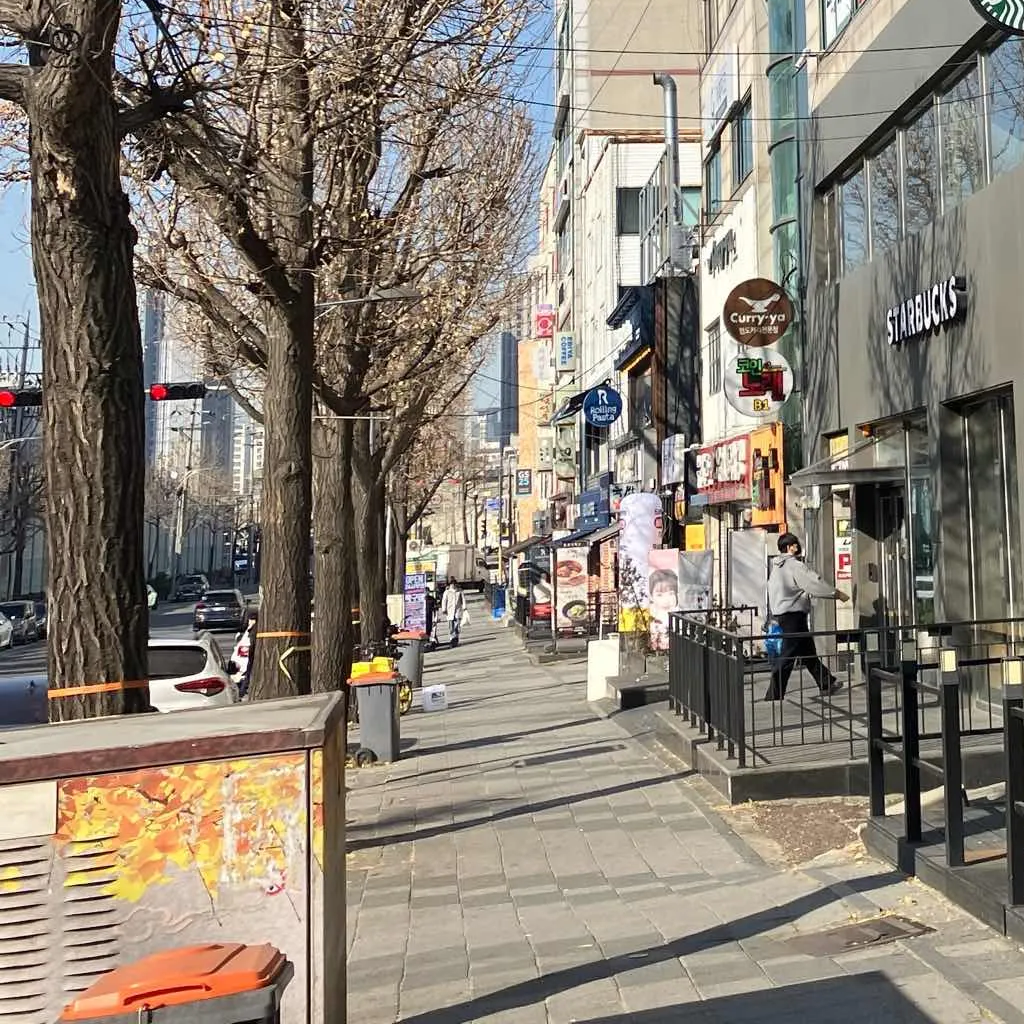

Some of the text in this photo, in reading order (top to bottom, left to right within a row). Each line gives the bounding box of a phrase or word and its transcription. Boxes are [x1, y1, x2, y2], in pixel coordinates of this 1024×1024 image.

[886, 275, 957, 345] STARBUCKS
[736, 358, 763, 374] 코인
[590, 406, 617, 417] Rolling
[753, 399, 770, 412] B1
